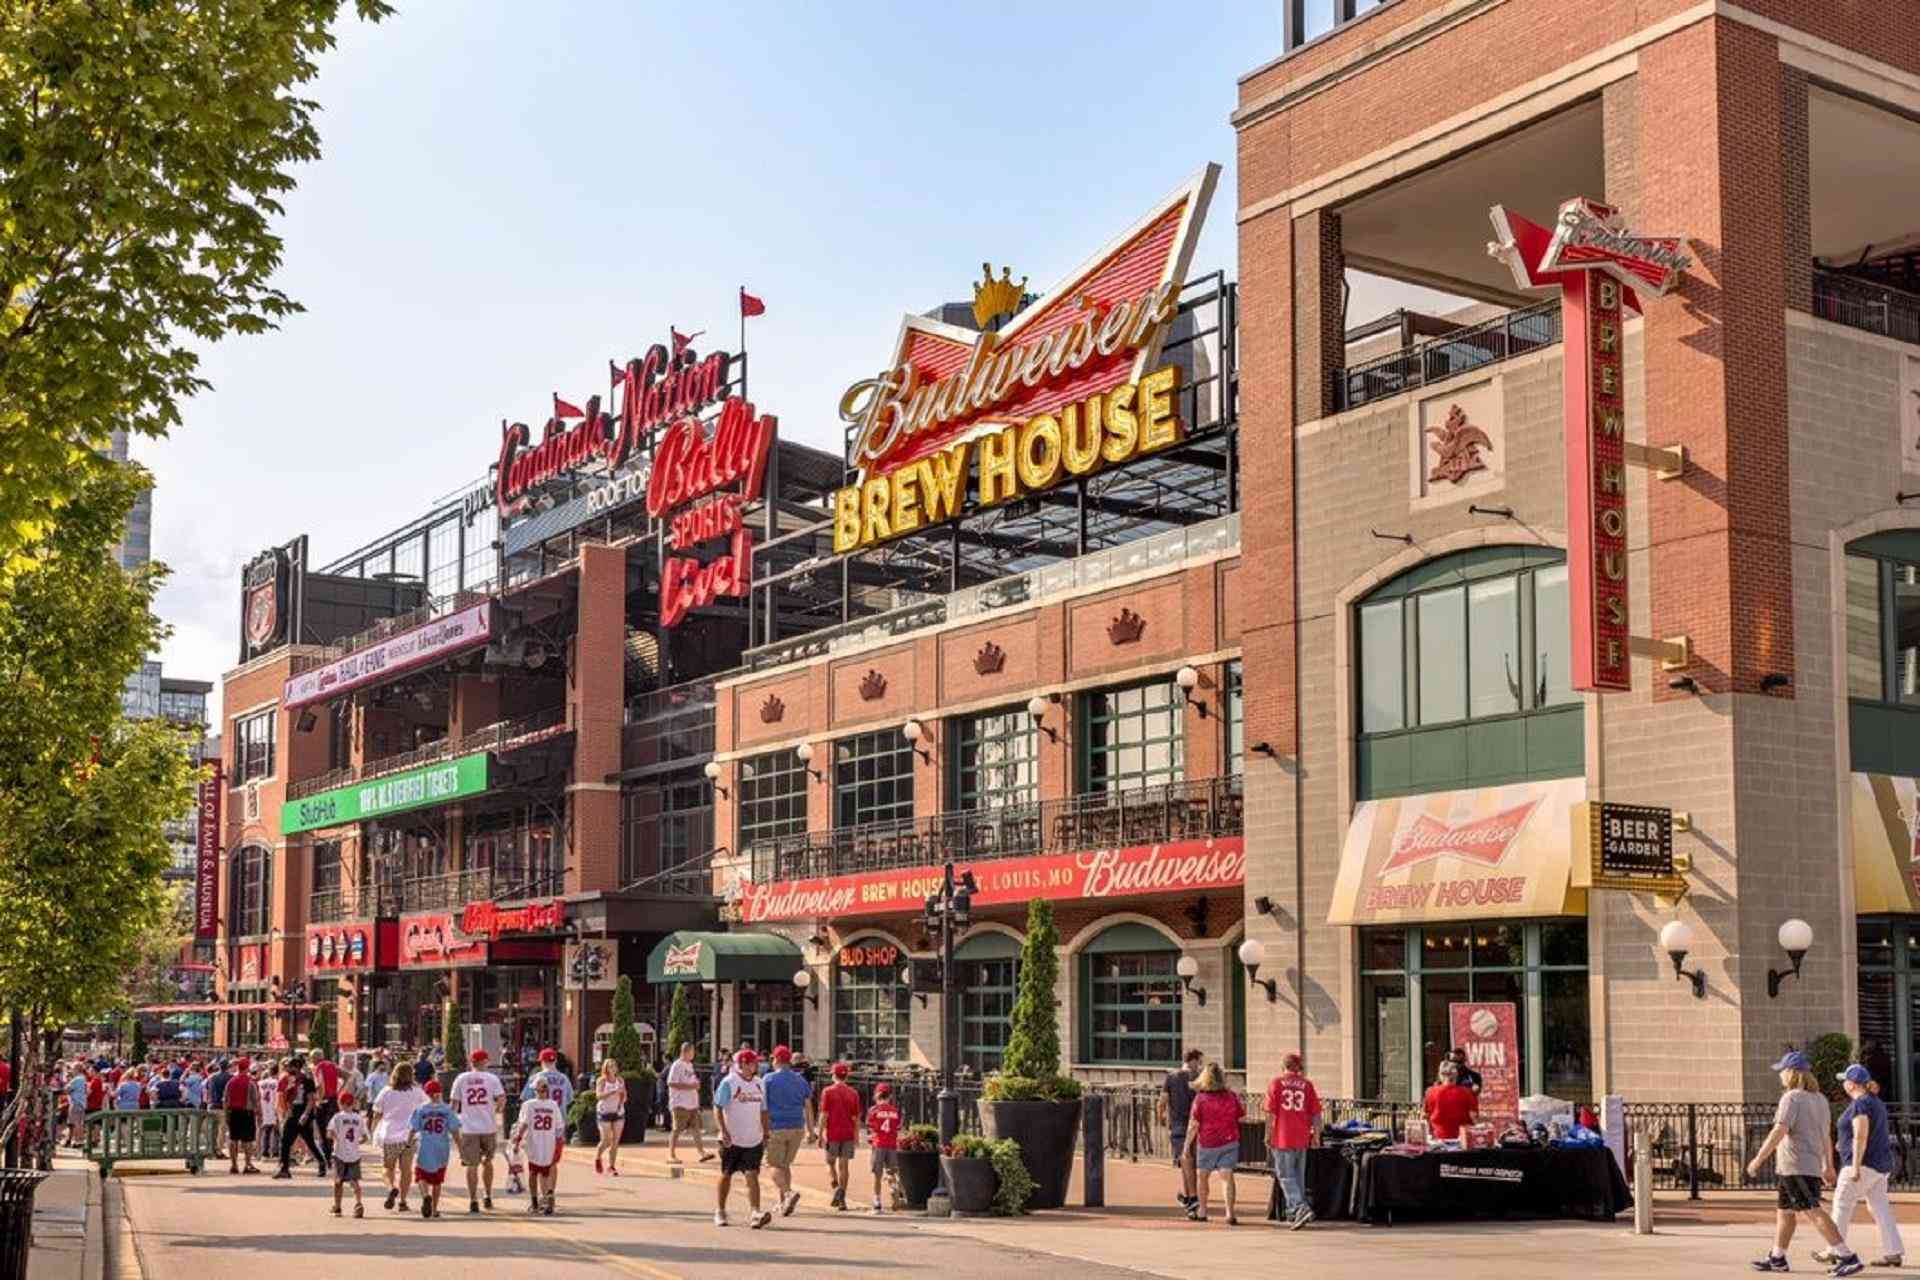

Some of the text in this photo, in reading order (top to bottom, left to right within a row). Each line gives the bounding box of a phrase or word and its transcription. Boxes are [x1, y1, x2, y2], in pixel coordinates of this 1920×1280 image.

[838, 282, 1172, 463] Budweiser
[497, 342, 731, 518] Cardinals Nation
[646, 395, 778, 518] Bally
[832, 365, 1185, 556] BREW HOUSE
[670, 496, 743, 550] SPORTS
[203, 802, 216, 818] OF
[203, 823, 217, 859] FAME
[1609, 818, 1660, 841] BEER
[1609, 840, 1661, 858] GARDEN
[202, 860, 215, 871] &
[200, 874, 214, 929] MUSEUM
[744, 878, 857, 922] Budweiser
[861, 883, 898, 902] BREW
[902, 877, 946, 900] HOUS
[1366, 876, 1527, 912] BREW HOUSE
[840, 947, 898, 967] BUD SHOP
[1464, 1042, 1505, 1067] WIN
[466, 1087, 487, 1105] 22
[1281, 1089, 1305, 1111] 33
[423, 1118, 443, 1134] 46
[534, 1114, 553, 1130] 28
[880, 1118, 891, 1133] 4
[345, 1127, 355, 1142] 4
